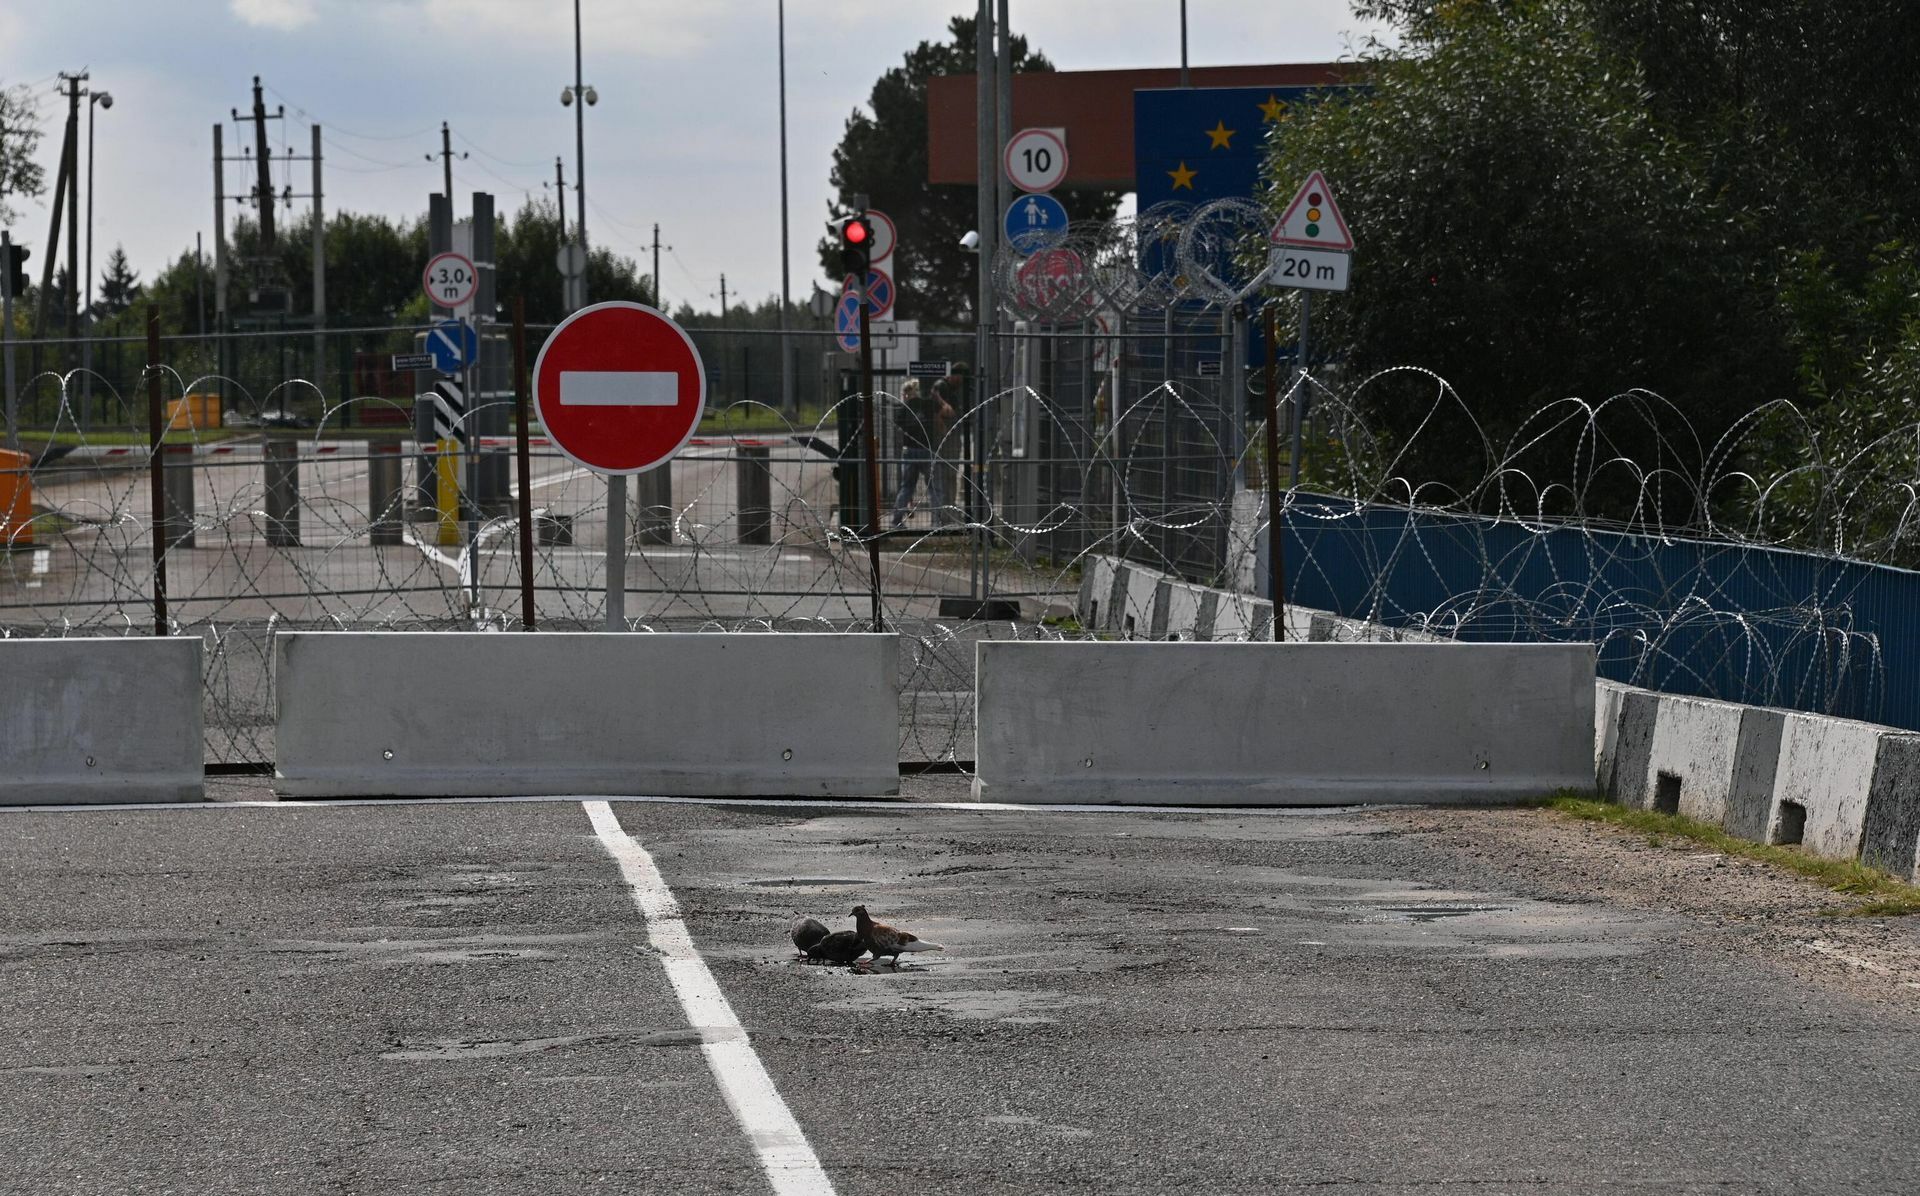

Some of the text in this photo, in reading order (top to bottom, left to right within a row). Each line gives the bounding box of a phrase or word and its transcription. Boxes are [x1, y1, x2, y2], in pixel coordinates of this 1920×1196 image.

[1022, 148, 1051, 173] 10
[438, 268, 464, 284] 3.0
[1283, 258, 1334, 280] 20 m
[444, 288, 458, 298] m
